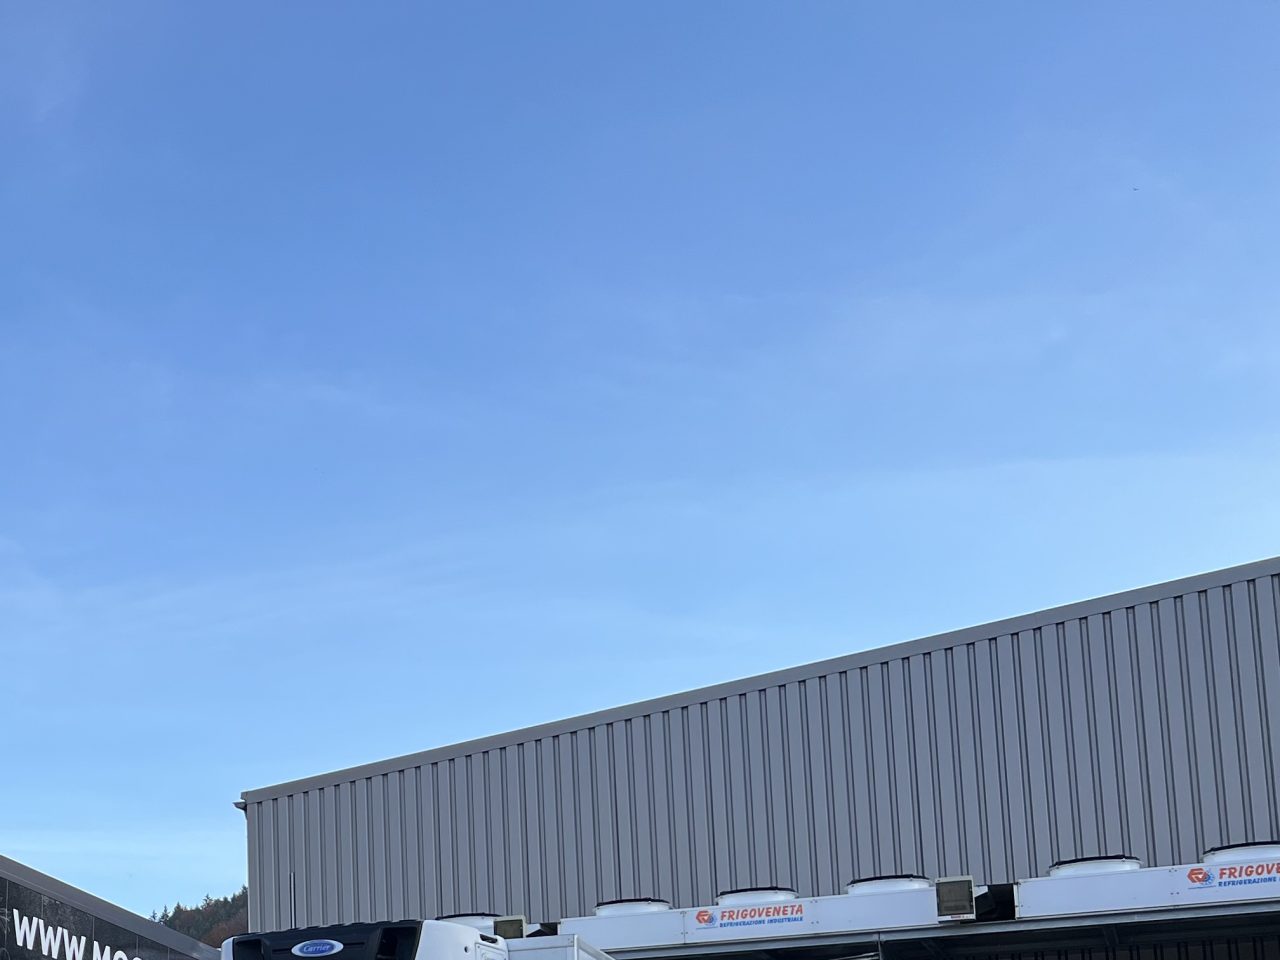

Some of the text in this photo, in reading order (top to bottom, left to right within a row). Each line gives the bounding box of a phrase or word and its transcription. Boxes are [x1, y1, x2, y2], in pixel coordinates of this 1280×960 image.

[1218, 876, 1277, 887] REFRIGERAZIONE
[720, 904, 803, 920] FRIGOVENETA
[720, 916, 803, 928] REFRIGERAZIONE INDUSTRIALE
[303, 943, 330, 952] Carrier
